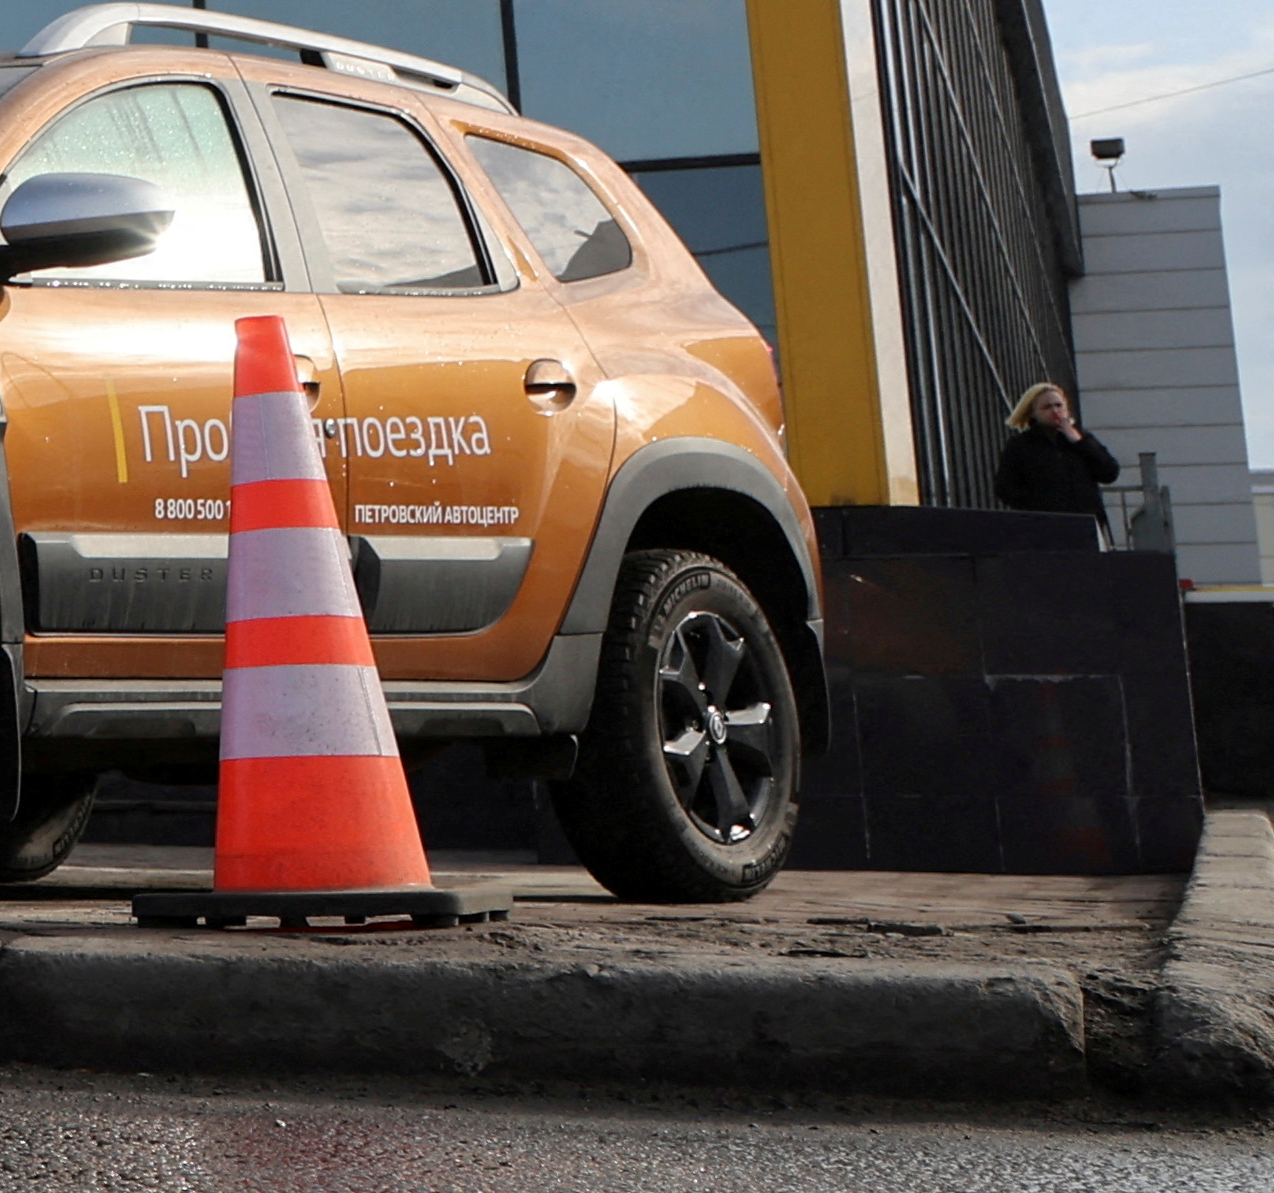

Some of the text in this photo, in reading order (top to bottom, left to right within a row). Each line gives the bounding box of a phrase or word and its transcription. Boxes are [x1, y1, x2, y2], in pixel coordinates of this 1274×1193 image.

[138, 405, 492, 478] Проя поездка
[154, 498, 165, 520] 8
[167, 499, 195, 520] 800
[196, 499, 224, 520] 500
[355, 501, 520, 527] ПЕТРОВСКИЙ АВТОЦЕНТР
[89, 568, 214, 582] DUSTER
